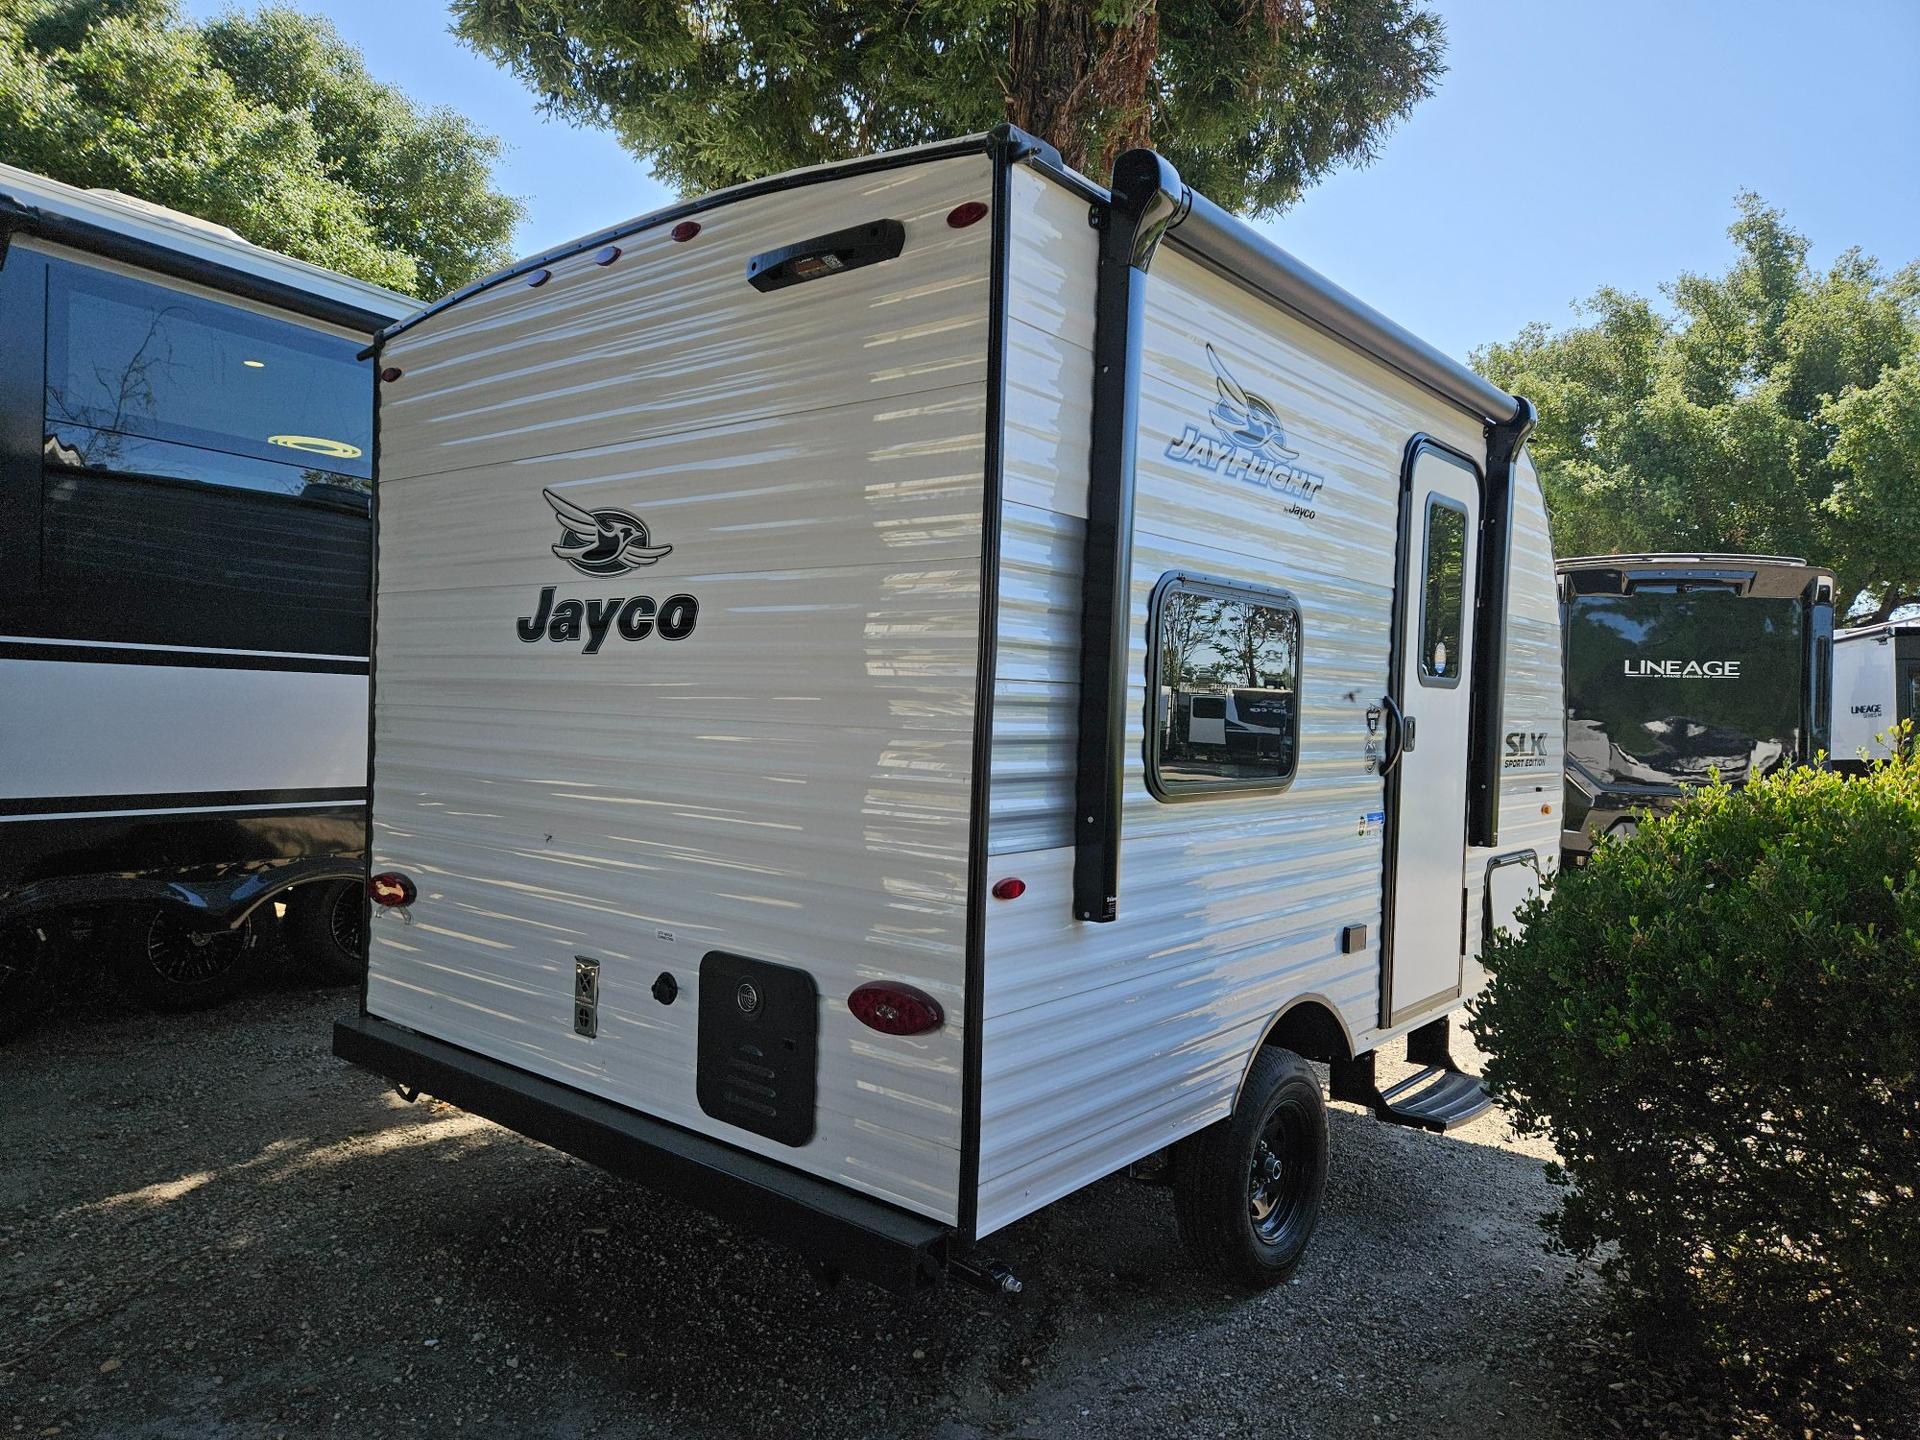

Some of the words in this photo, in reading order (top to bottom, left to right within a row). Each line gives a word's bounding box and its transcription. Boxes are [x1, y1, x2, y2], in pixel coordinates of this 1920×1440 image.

[1288, 502, 1316, 520] Jayco
[516, 586, 699, 654] Jayco
[1624, 659, 1741, 676] LINEAGE
[1850, 704, 1881, 714] LINEAGE
[1504, 759, 1524, 768] SPORT
[1525, 758, 1546, 767] EDITION
